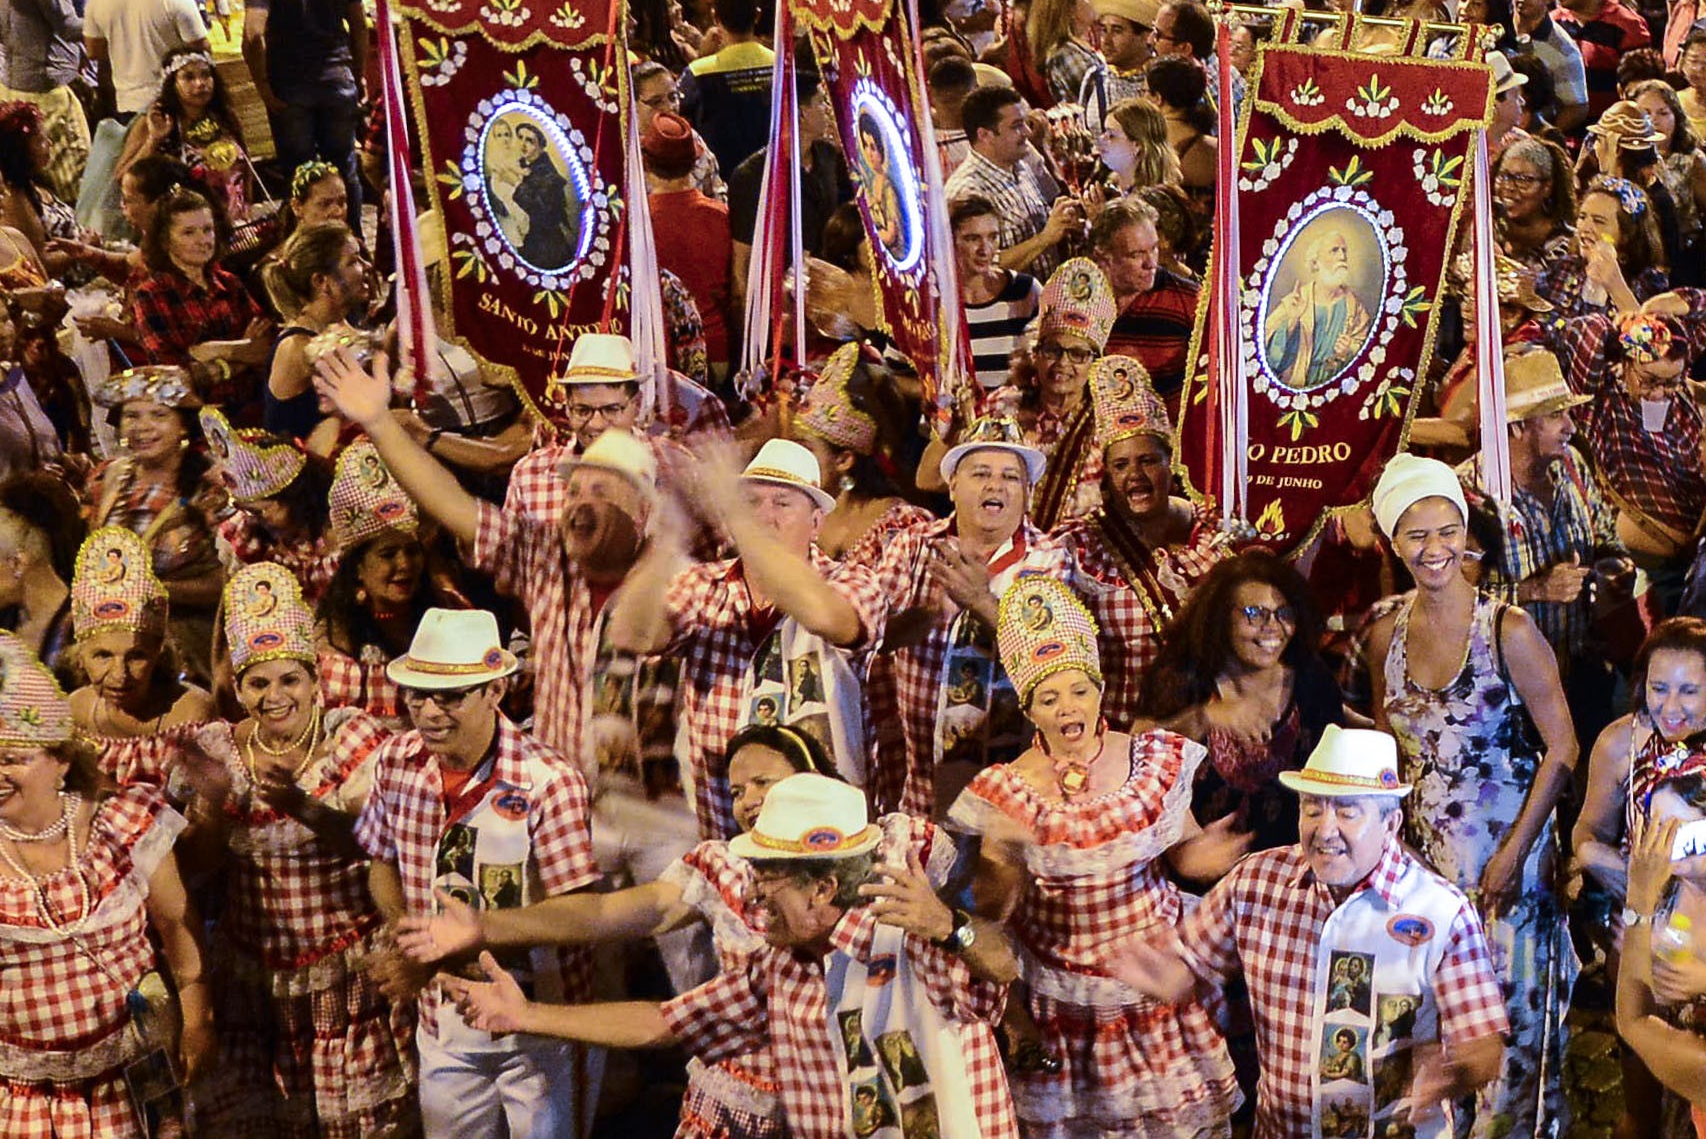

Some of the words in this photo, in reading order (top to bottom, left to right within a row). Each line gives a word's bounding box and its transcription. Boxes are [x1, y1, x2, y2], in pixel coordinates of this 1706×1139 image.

[478, 292, 538, 336] SANTO
[545, 317, 623, 341] ANTOIO
[1270, 442, 1352, 464] PEDRO
[1256, 474, 1275, 486] DE
[1276, 476, 1323, 490] JUNHO
